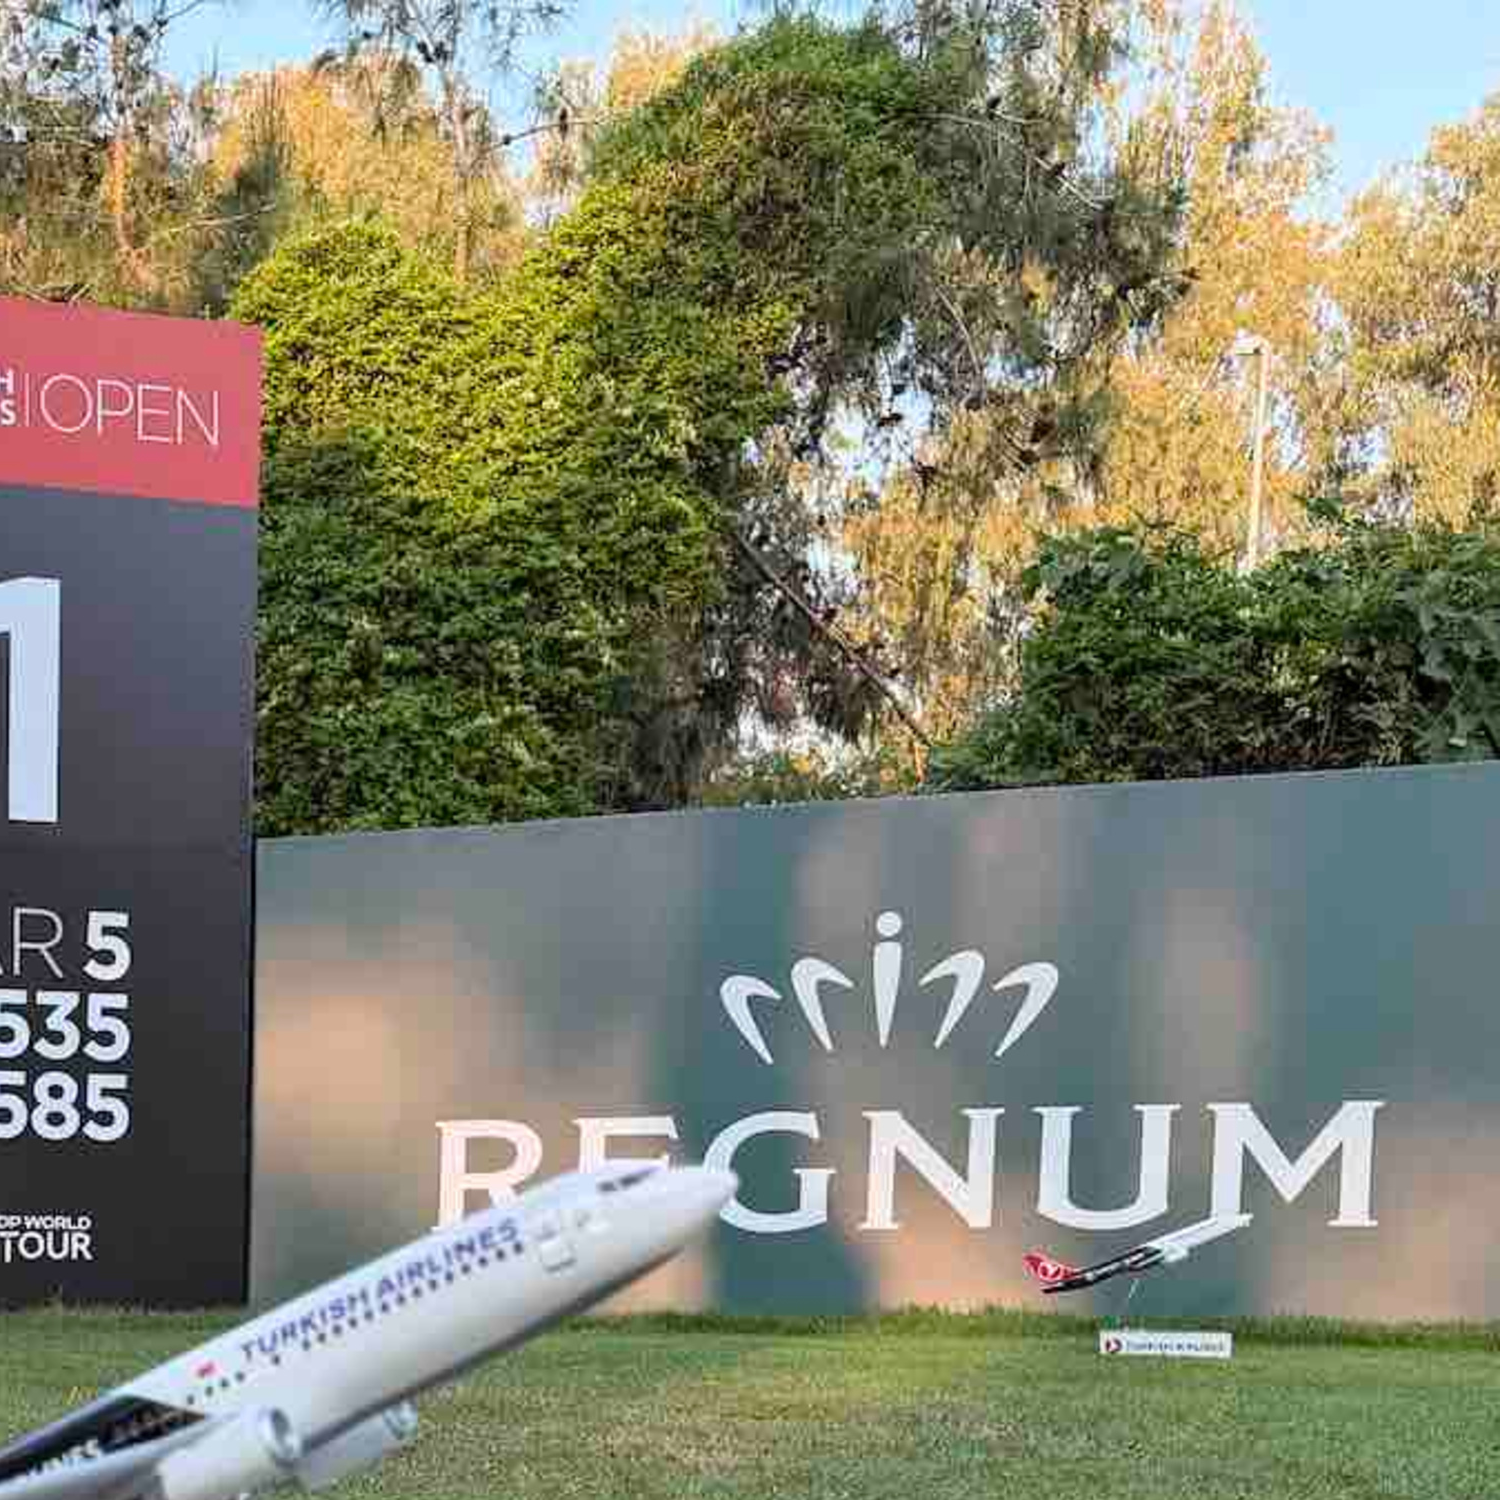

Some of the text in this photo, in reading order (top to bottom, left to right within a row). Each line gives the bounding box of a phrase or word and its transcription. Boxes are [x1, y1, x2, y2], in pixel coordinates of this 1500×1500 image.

[40, 373, 220, 446] OPEN
[83, 910, 132, 981] 5
[23, 1216, 92, 1230] WORLD
[239, 1217, 523, 1362] TURKISH AIRLINES
